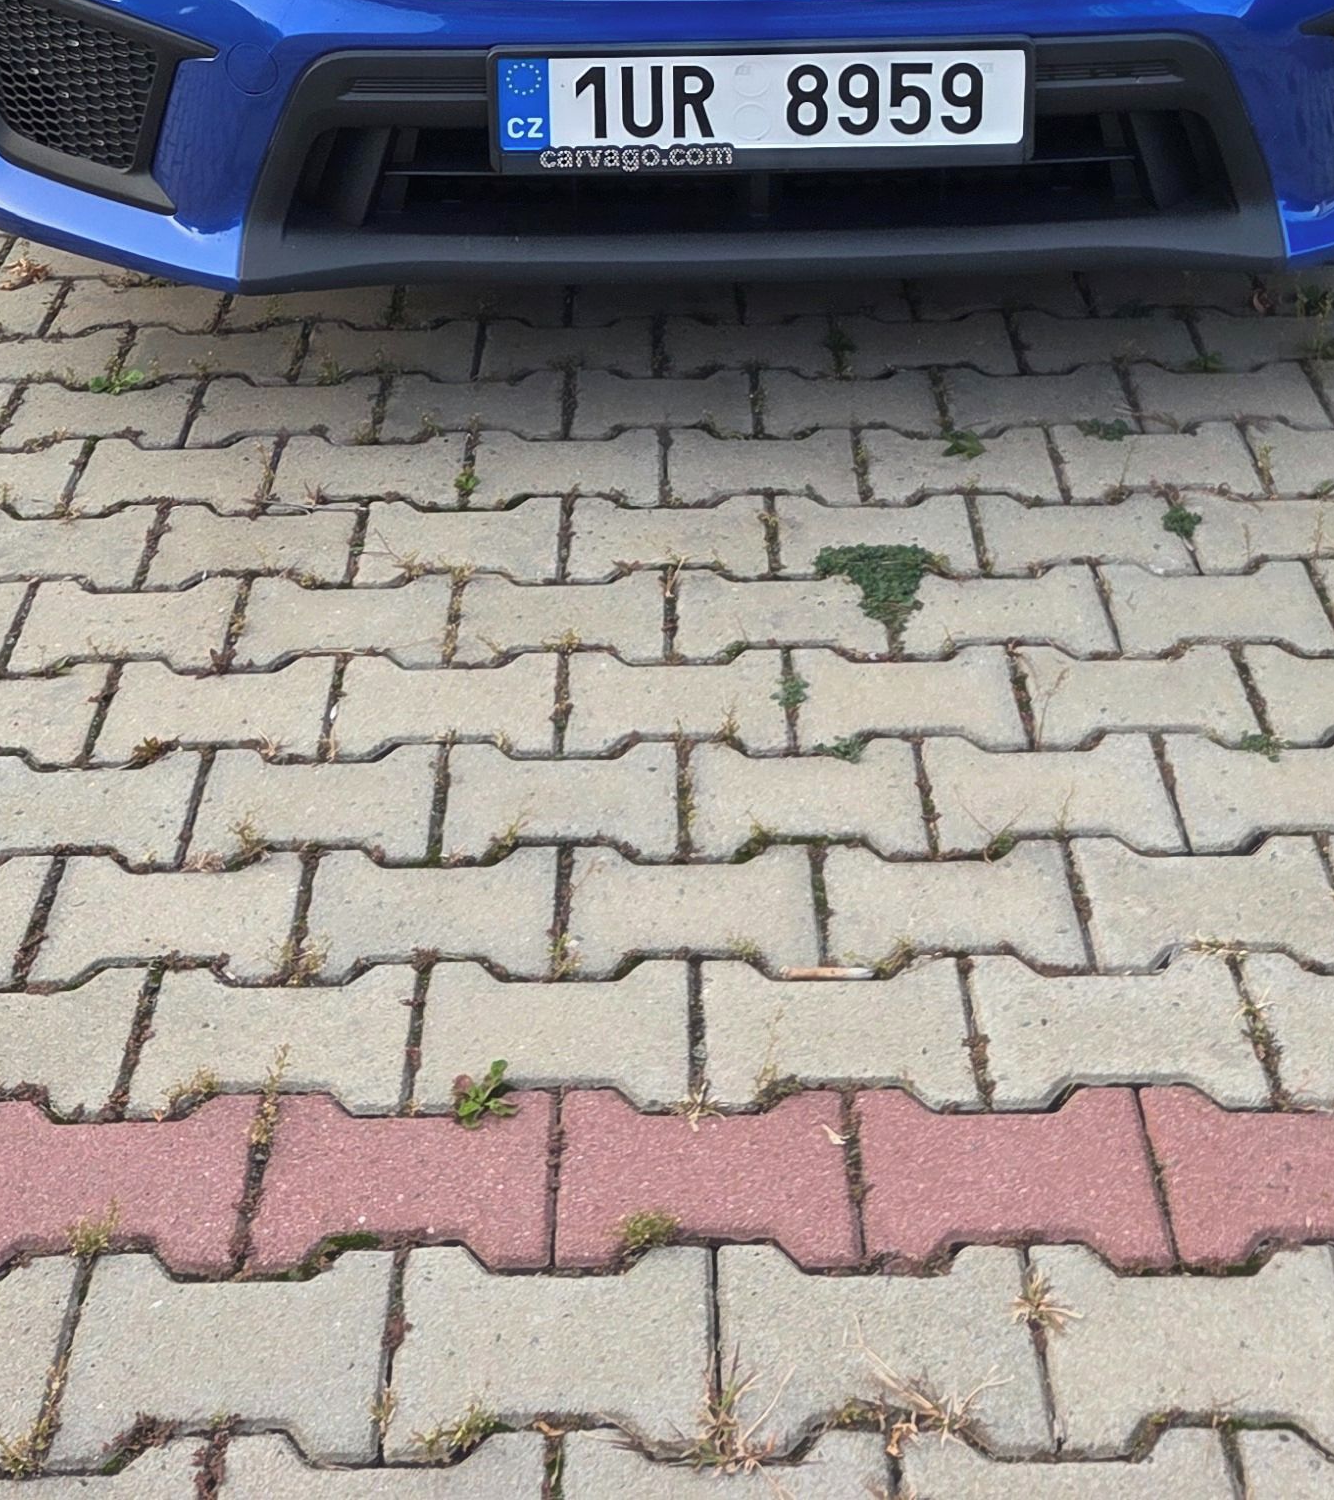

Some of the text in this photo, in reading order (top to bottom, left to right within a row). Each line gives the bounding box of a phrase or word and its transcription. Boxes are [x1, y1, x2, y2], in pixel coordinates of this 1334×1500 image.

[575, 62, 984, 139] 1UR 8959
[507, 117, 543, 139] CZ
[539, 146, 733, 172] carvago.com
